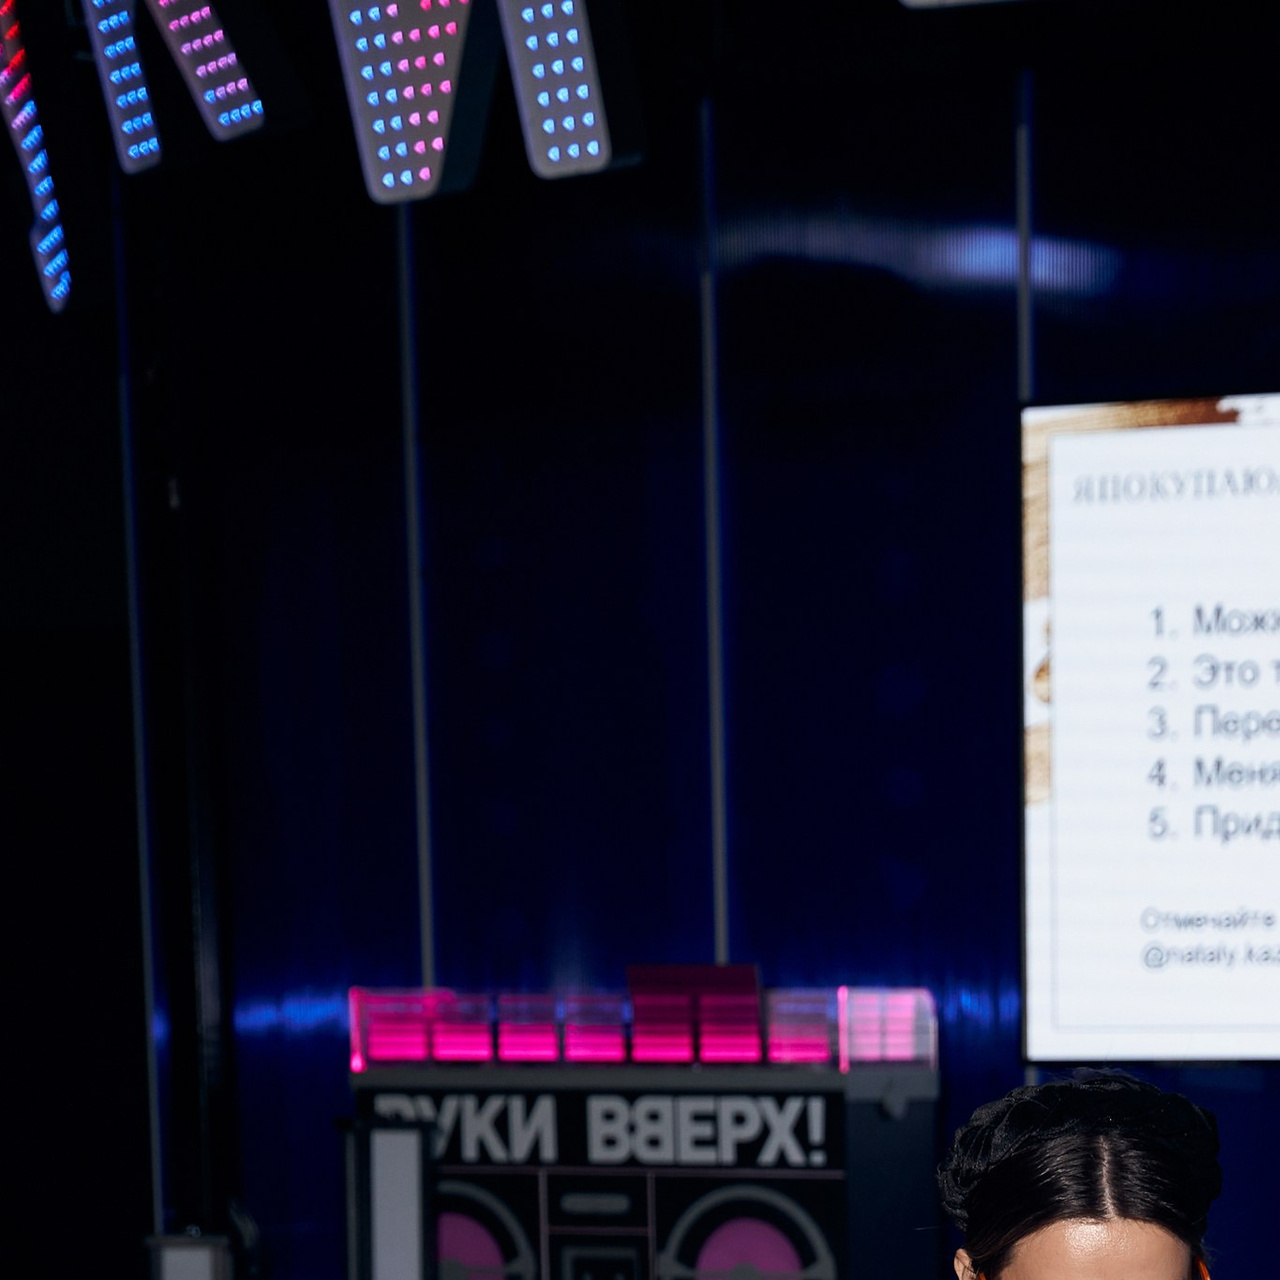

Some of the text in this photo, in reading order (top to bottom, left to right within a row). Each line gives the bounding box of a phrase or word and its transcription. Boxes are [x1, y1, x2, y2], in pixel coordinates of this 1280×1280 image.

[1148, 606, 1178, 637] 1.
[1148, 656, 1178, 691] 2.
[1194, 654, 1260, 689] Это
[1148, 706, 1178, 741] 3.
[1148, 758, 1178, 787] 4.
[1148, 806, 1178, 840] 5.
[1141, 909, 1276, 930] Отмечайте
